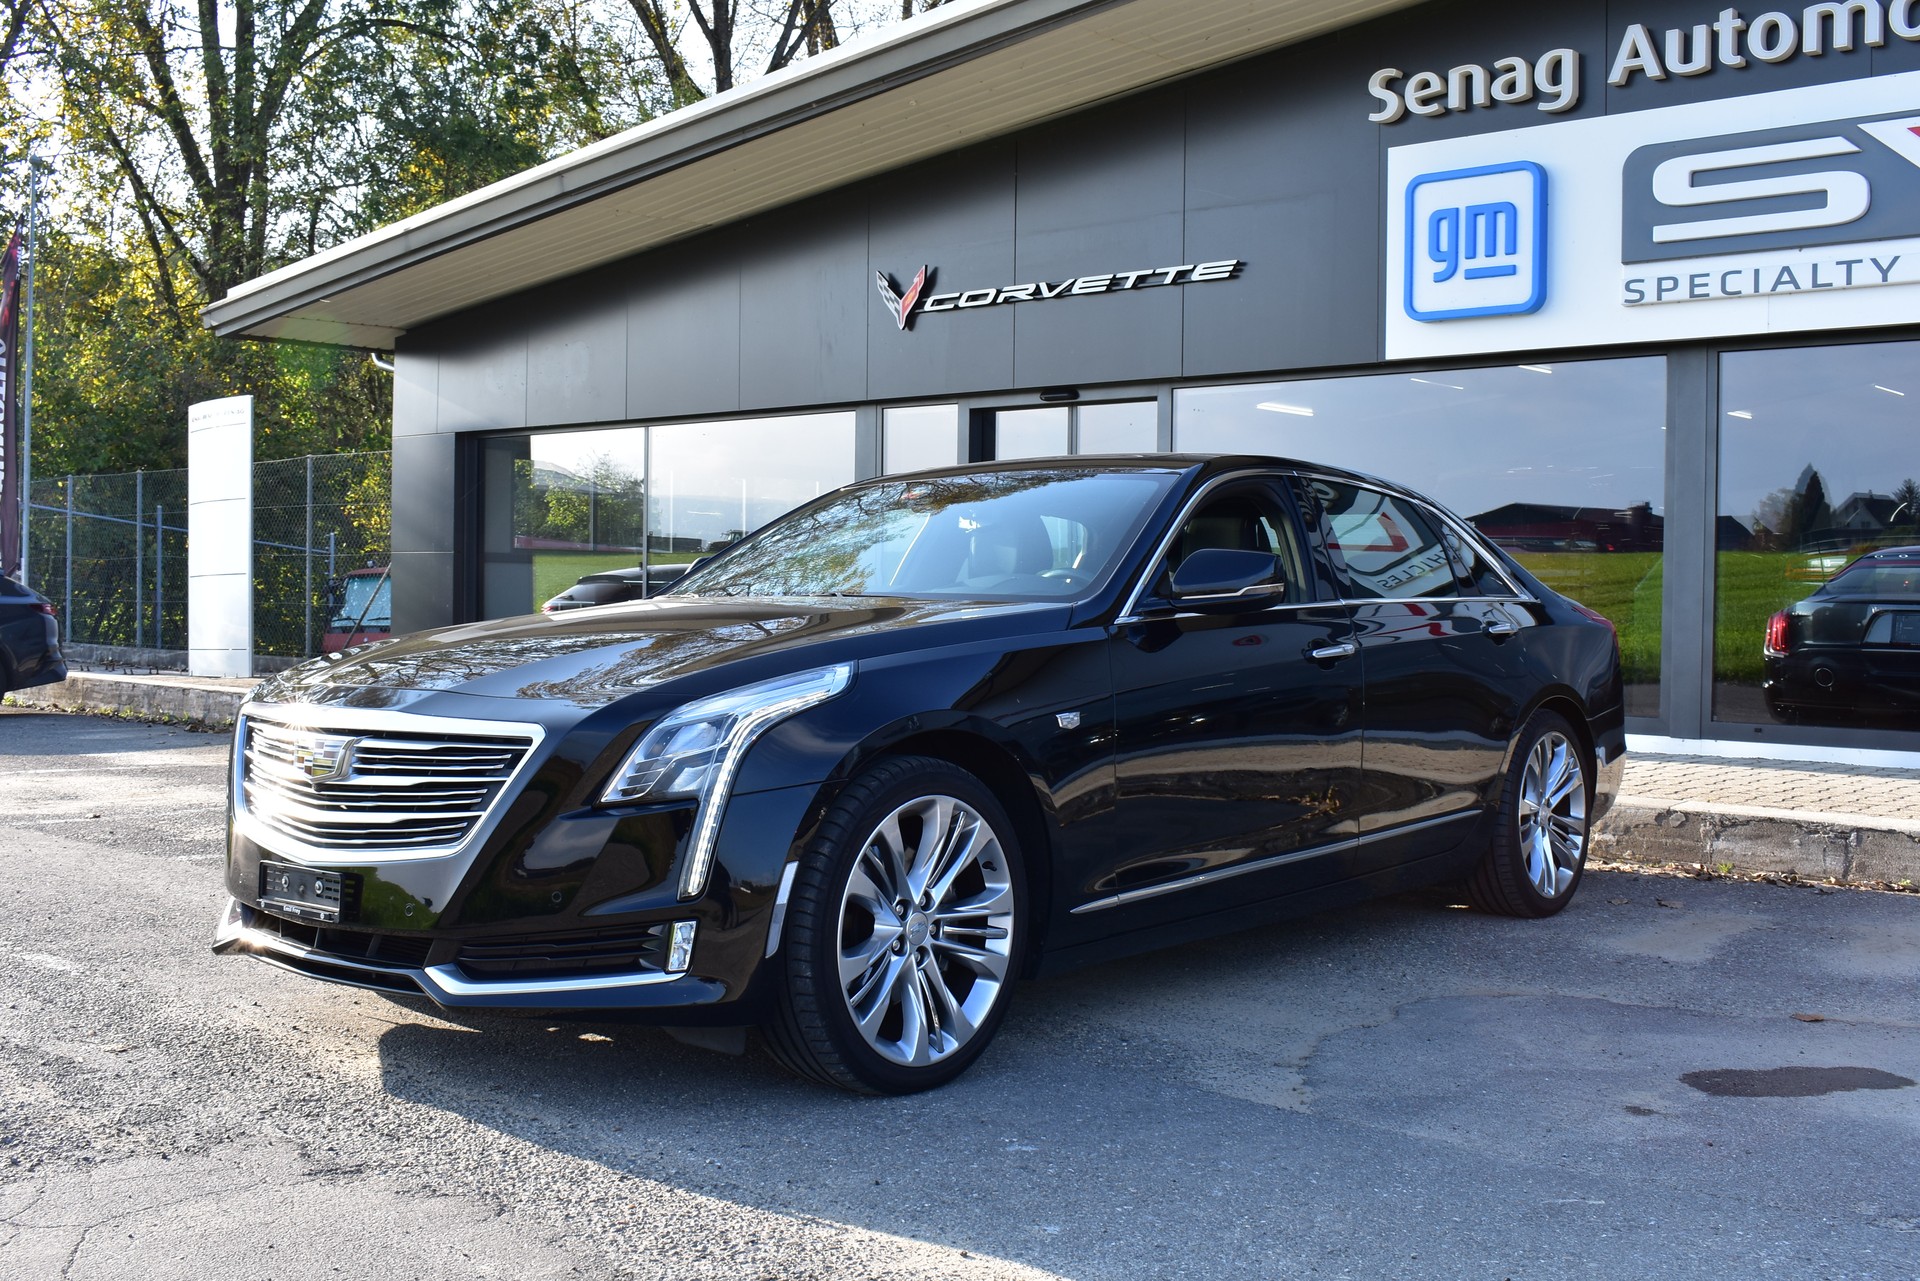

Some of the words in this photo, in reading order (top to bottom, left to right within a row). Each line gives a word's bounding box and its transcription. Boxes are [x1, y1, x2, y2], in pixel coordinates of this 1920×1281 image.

[1368, 48, 1580, 124] Senag
[1653, 115, 1920, 243] S
[1428, 201, 1517, 283] gm
[1624, 255, 1901, 304] SPECIALTY
[923, 259, 1240, 312] CORVETTE
